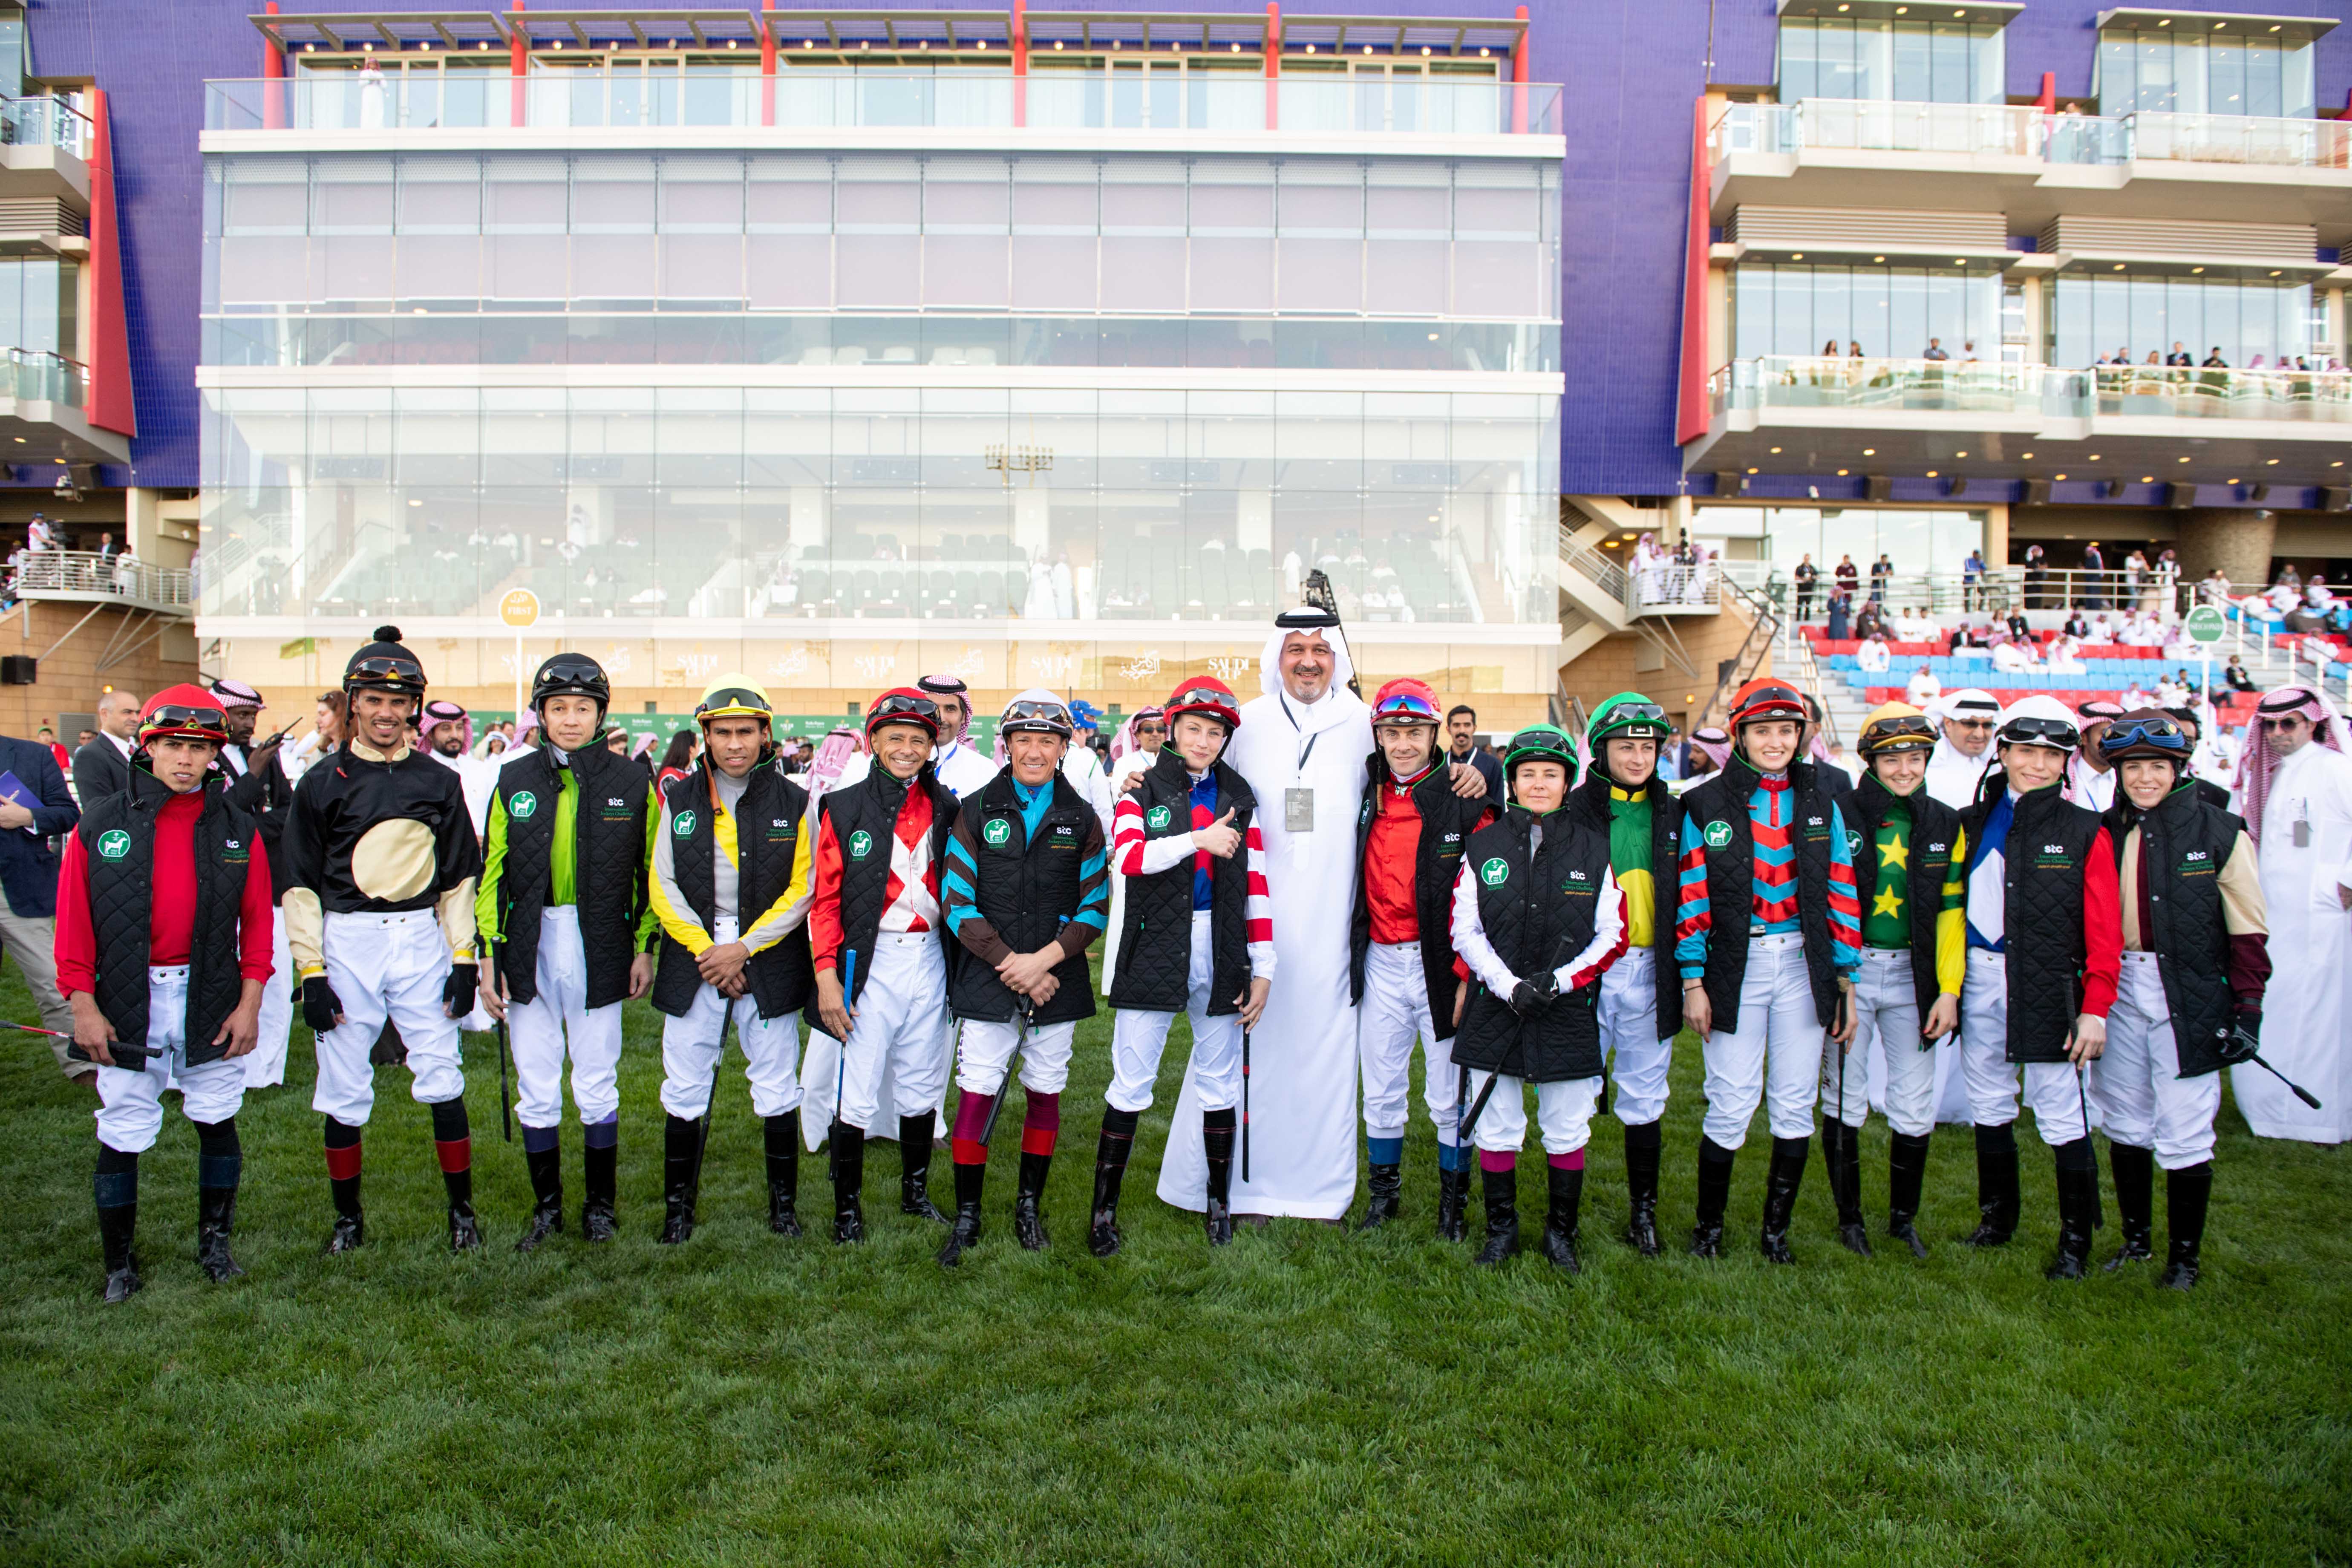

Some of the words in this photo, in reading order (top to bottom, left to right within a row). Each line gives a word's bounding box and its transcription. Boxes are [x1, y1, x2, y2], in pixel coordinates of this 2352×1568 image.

[676, 654, 718, 668] SAUDI
[854, 655, 895, 668] SAUDI
[1030, 656, 1072, 669] SAUDI
[1208, 657, 1249, 670] SAUDI
[1040, 668, 1064, 679] CUP
[1216, 670, 1241, 680] CUP
[608, 798, 623, 806] stc
[1808, 816, 1823, 825] stc
[1056, 826, 1072, 834] stc
[1444, 833, 1460, 842] stc
[1929, 843, 1945, 852] stc
[2044, 845, 2064, 853] stc
[2187, 851, 2207, 861] stc
[1570, 870, 1585, 880] stc
